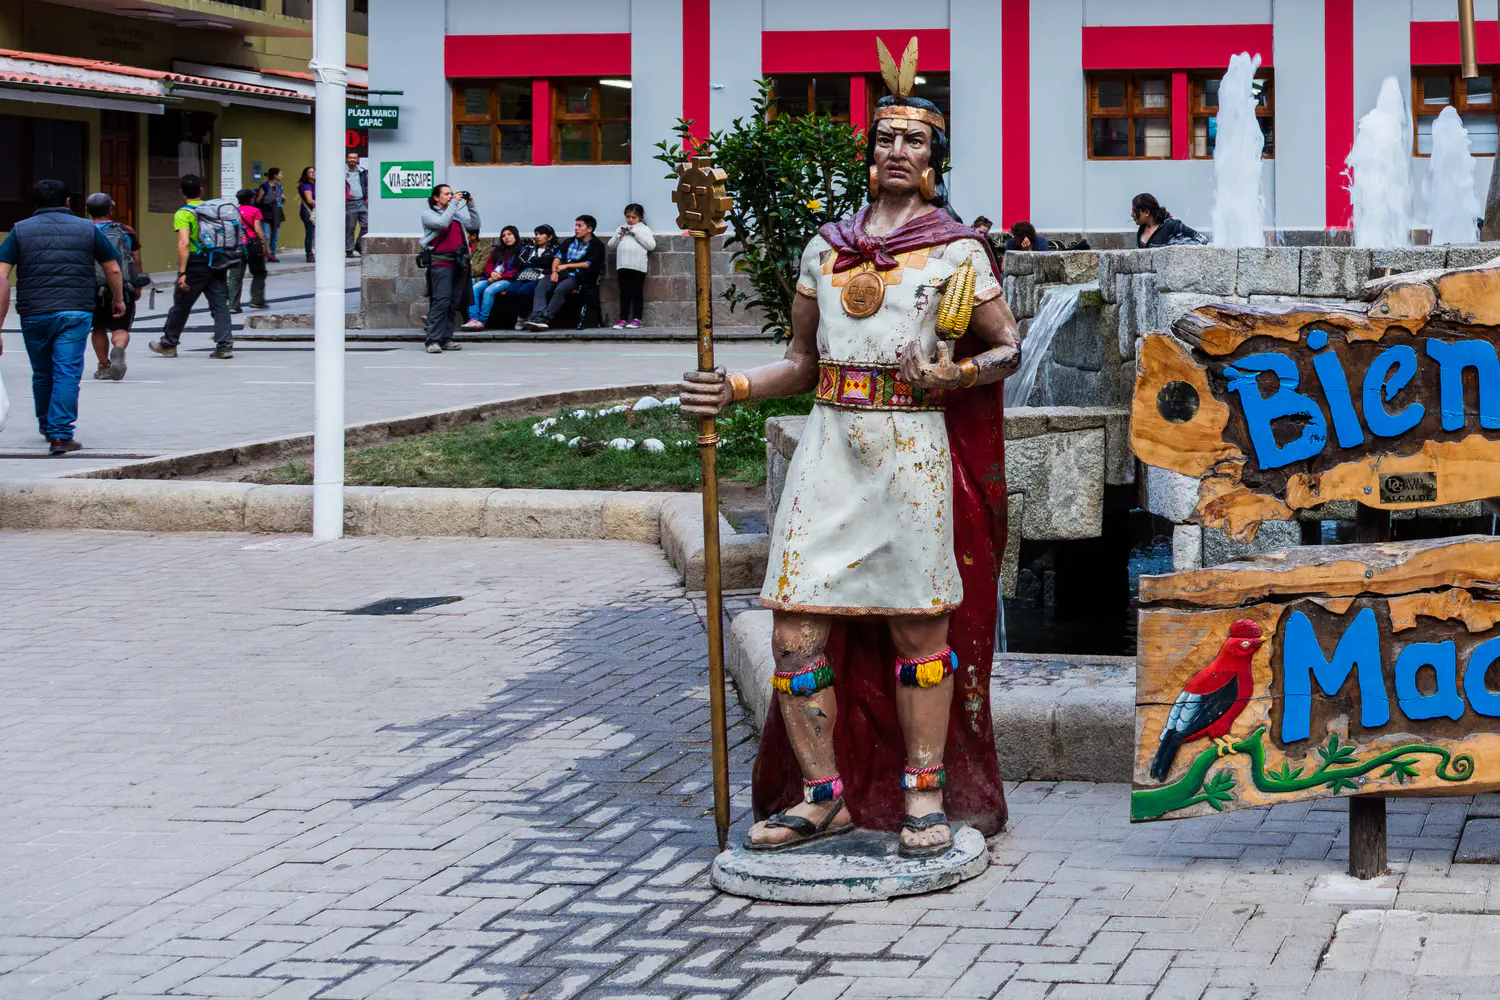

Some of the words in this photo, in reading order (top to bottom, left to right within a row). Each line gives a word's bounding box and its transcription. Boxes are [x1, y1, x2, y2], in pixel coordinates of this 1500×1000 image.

[347, 108, 371, 117] PLAZA
[371, 109, 398, 118] MANCO
[358, 118, 383, 127] CAPAC
[389, 172, 401, 187] VIA
[407, 172, 432, 187] ESCAPE
[1384, 494, 1433, 503] ALCALDE
